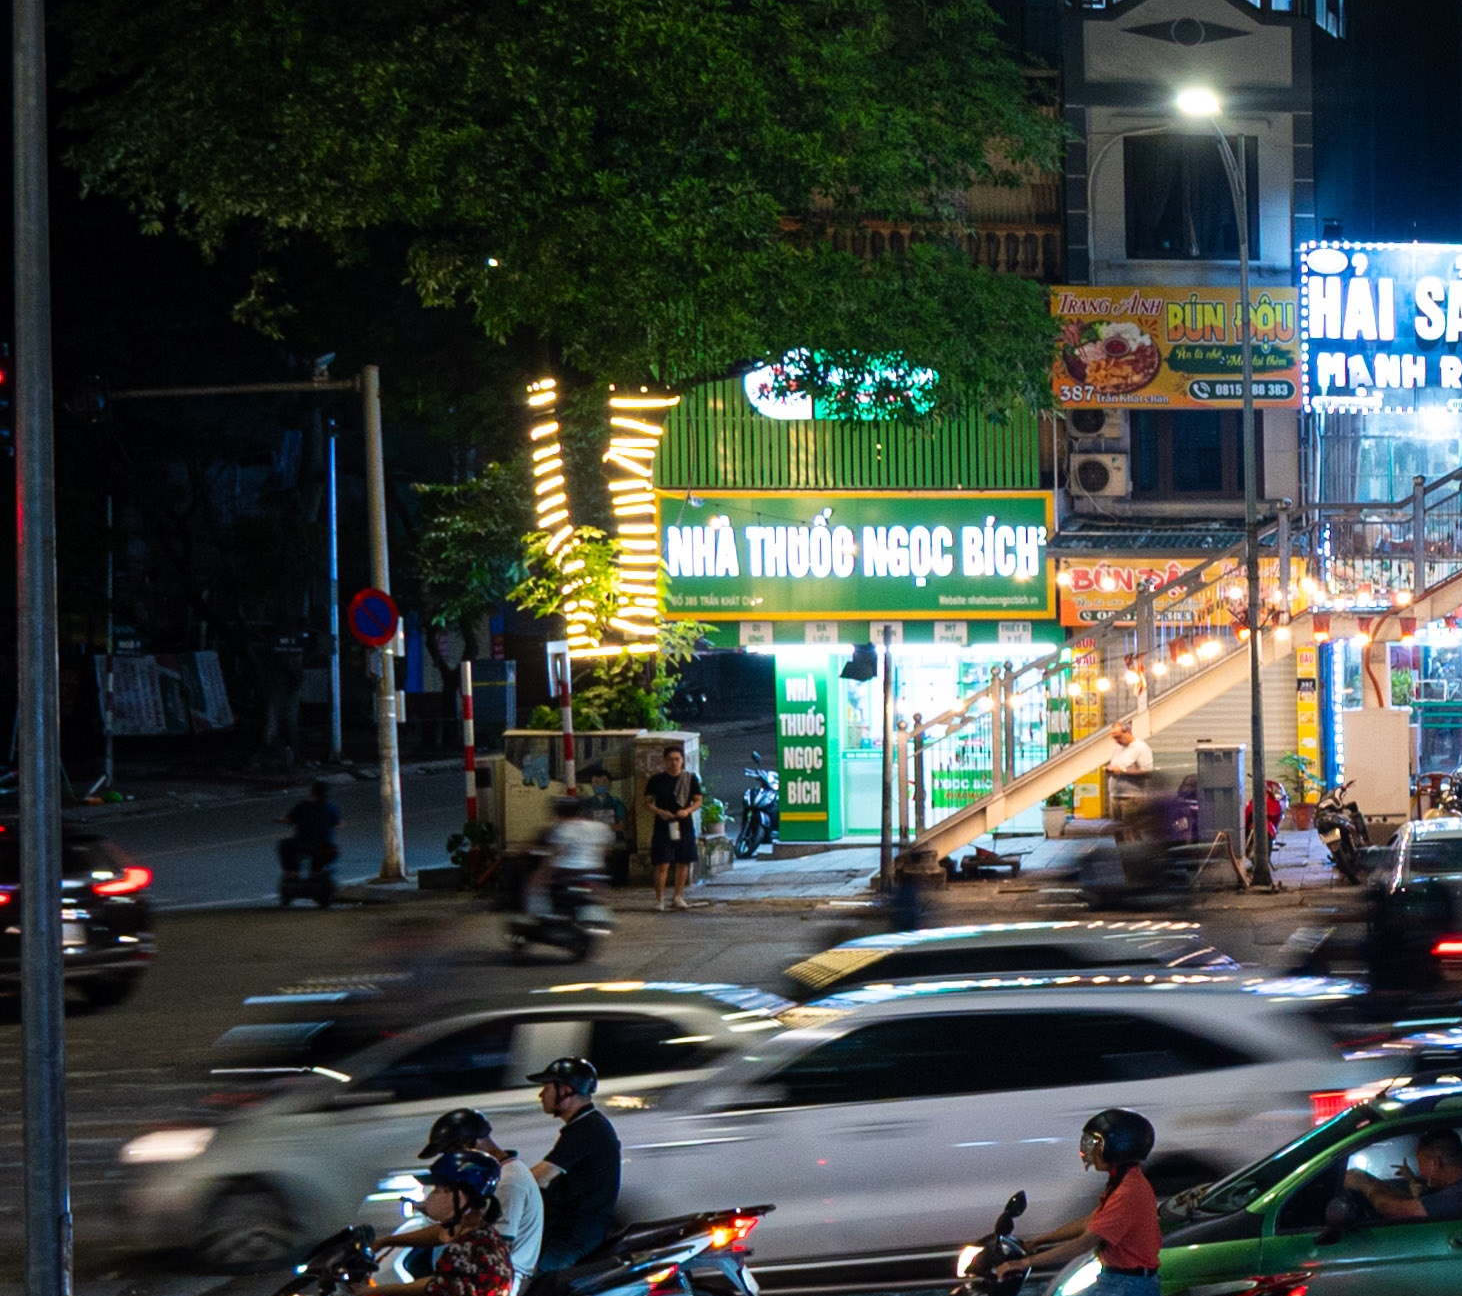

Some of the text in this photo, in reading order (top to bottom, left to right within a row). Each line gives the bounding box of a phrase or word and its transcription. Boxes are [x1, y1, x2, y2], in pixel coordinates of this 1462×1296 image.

[1308, 252, 1395, 342] HẢI
[1166, 293, 1227, 344] BÚN
[1317, 352, 1426, 397] MẠNH
[666, 514, 741, 578] NHÀ
[745, 506, 856, 579] THUỐC
[862, 525, 954, 588] NGỌC
[1069, 559, 1135, 593] BÚN
[785, 672, 818, 703] NHÀ
[779, 705, 826, 737] THUỐC
[783, 746, 824, 774] NGỌC
[787, 779, 822, 805] BÍCH
